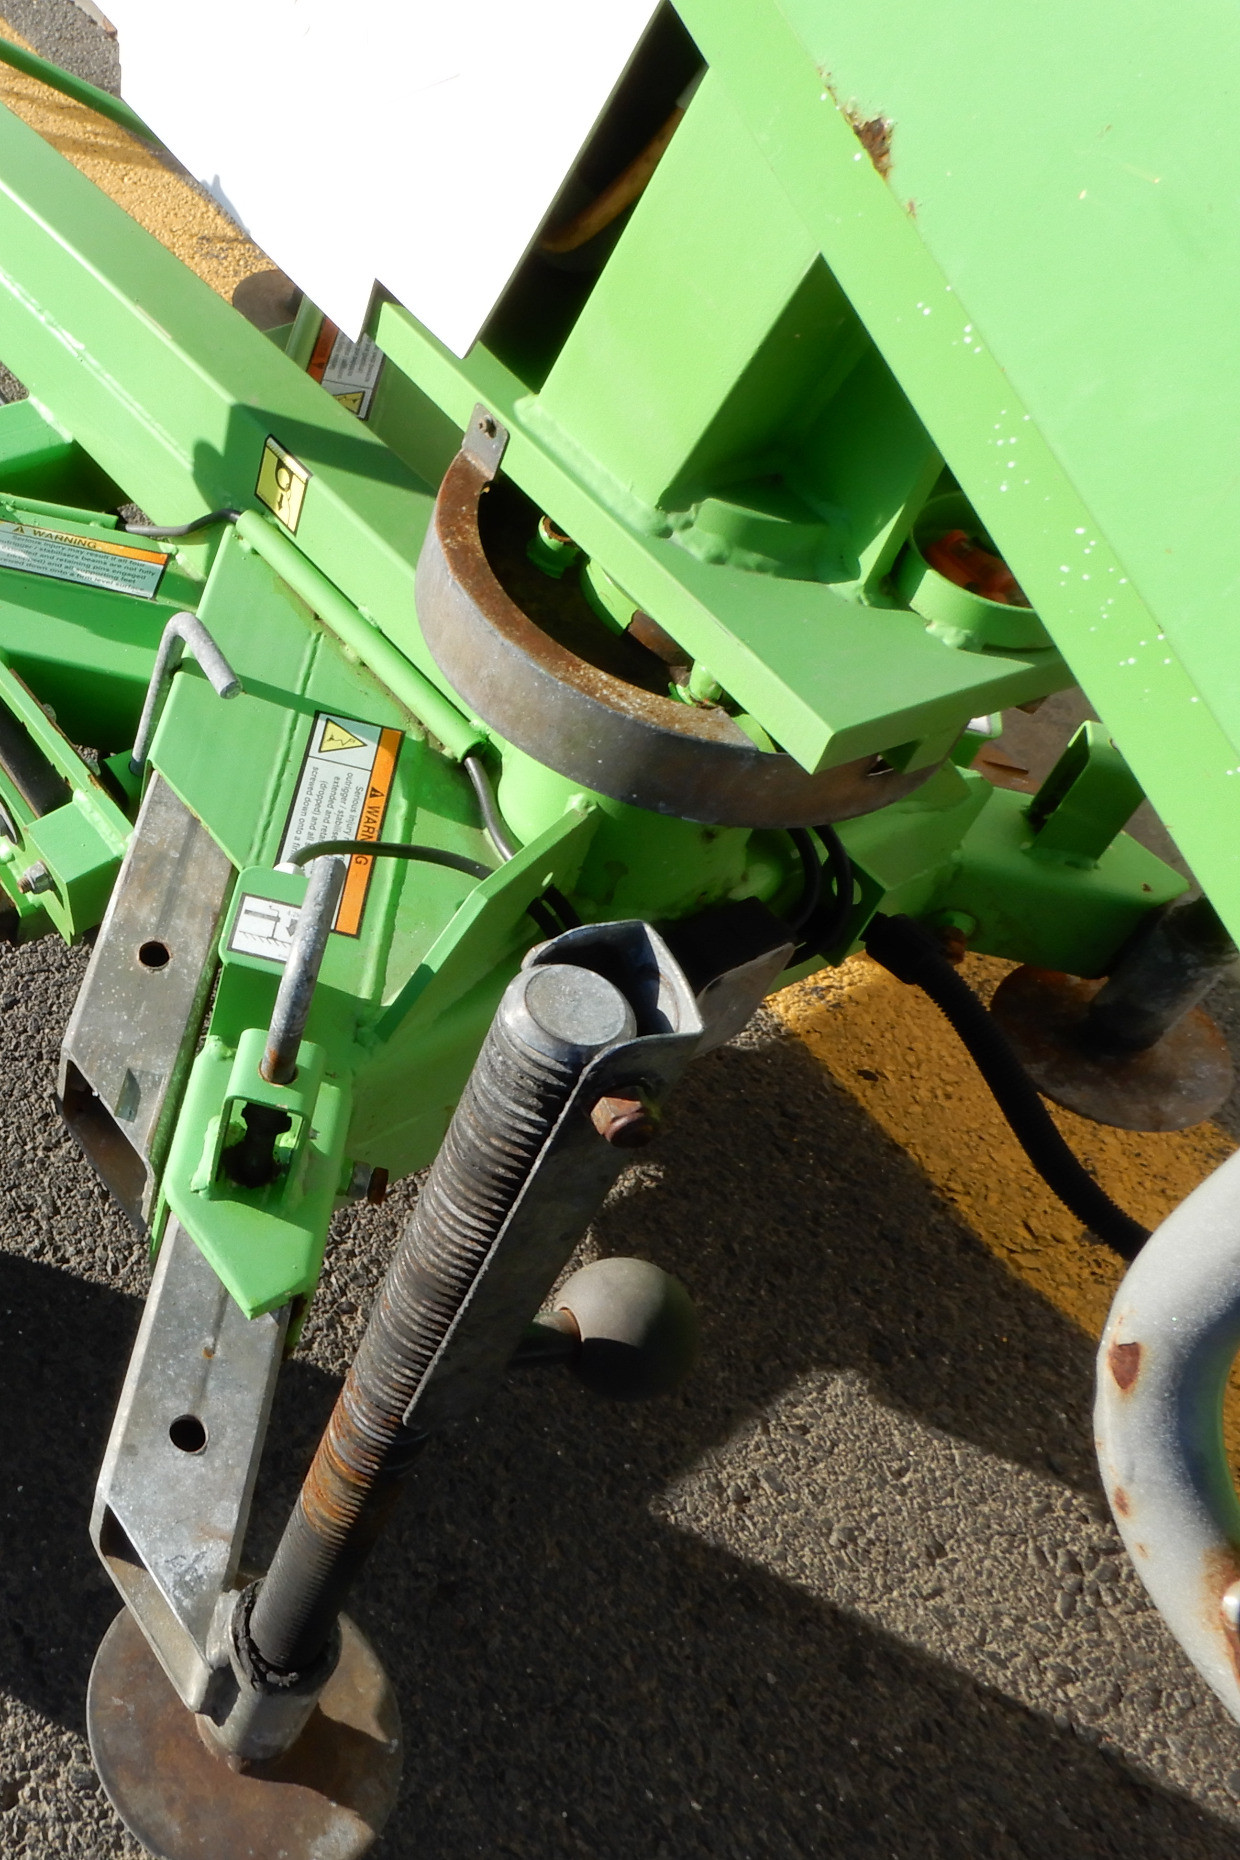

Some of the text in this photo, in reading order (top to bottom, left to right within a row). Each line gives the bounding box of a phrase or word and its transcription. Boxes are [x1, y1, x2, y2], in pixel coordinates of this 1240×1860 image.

[31, 529, 98, 548] WARNING
[39, 552, 54, 560] and
[55, 556, 91, 568] retaining
[92, 564, 110, 573] pins
[111, 569, 146, 580] engaged
[42, 541, 65, 550] injury
[67, 546, 84, 555] may
[86, 550, 108, 559] result
[128, 558, 145, 567] four
[81, 555, 107, 565] beams
[138, 567, 156, 577] fully
[47, 560, 63, 568] and
[119, 576, 136, 584] feet
[305, 765, 319, 796] screwed
[326, 775, 341, 809] extended
[337, 771, 354, 805] outrigger
[299, 796, 311, 817] down
[310, 779, 328, 815] (dropped)
[349, 785, 363, 813] Serious
[295, 817, 305, 835] onto
[308, 815, 319, 831] and
[322, 809, 332, 824] and
[330, 809, 345, 842] stabilise
[342, 813, 356, 836] injury
[305, 830, 315, 841] all
[354, 804, 380, 866] WARNG
